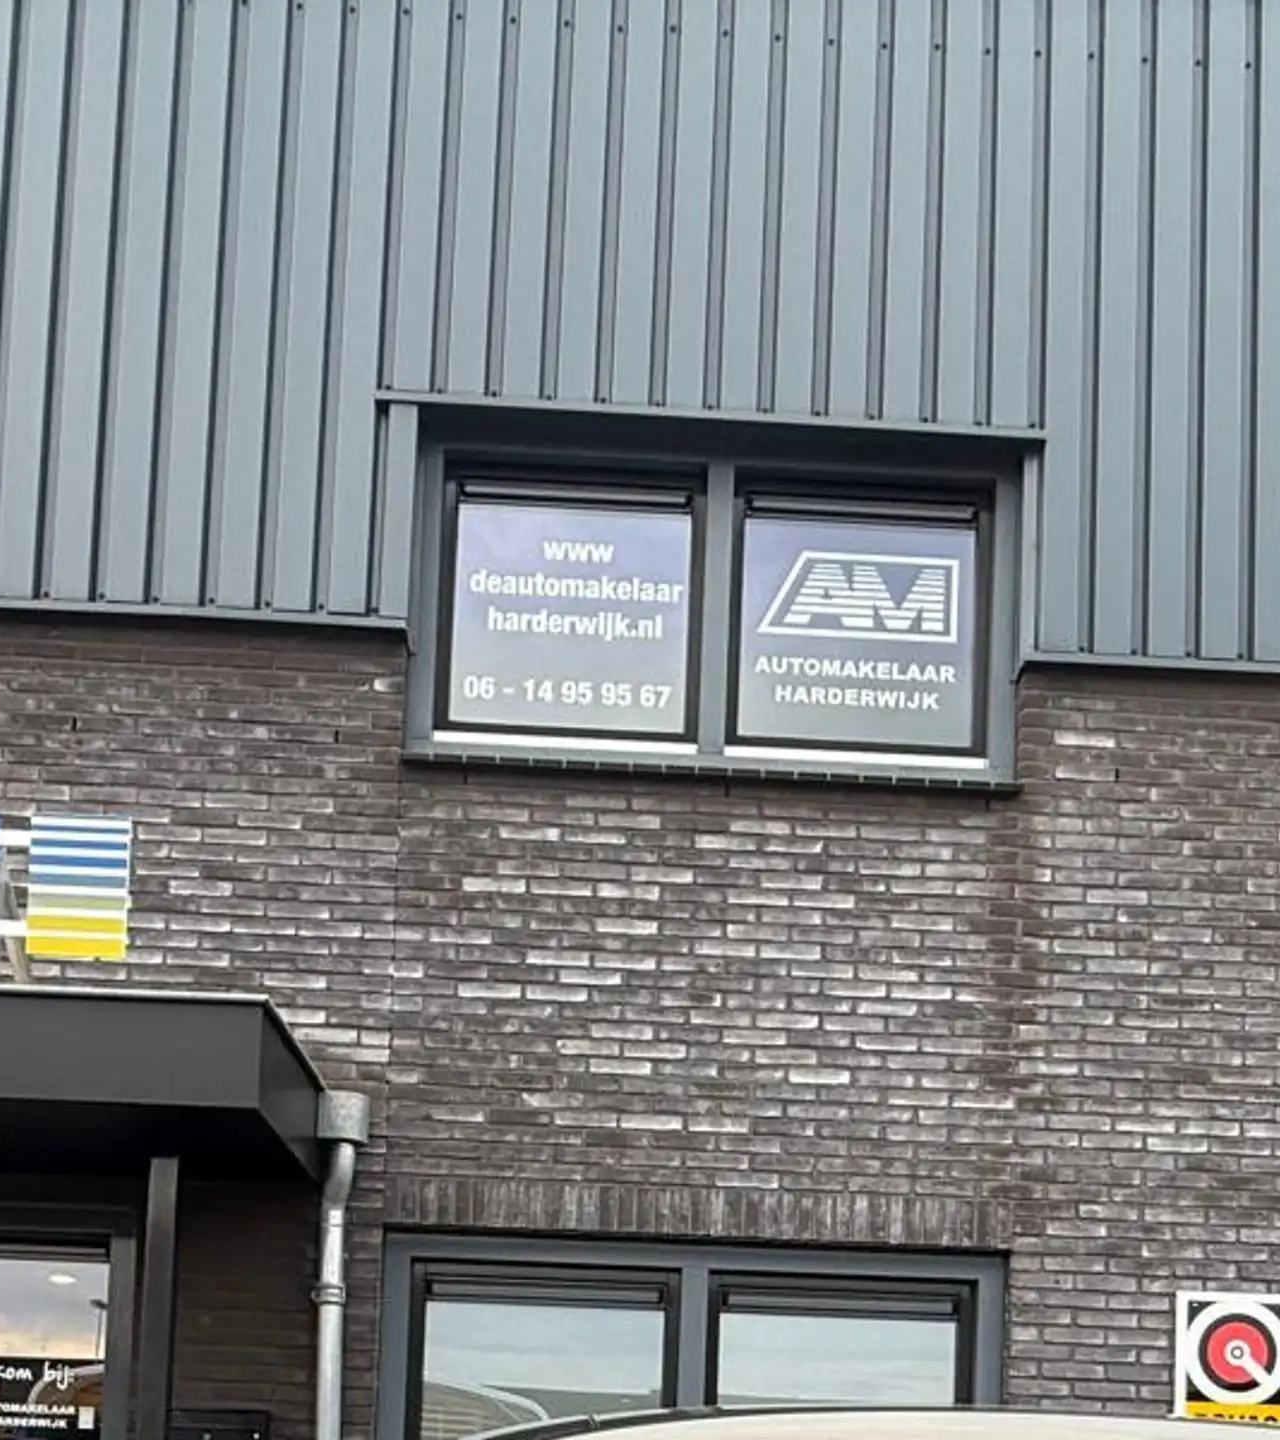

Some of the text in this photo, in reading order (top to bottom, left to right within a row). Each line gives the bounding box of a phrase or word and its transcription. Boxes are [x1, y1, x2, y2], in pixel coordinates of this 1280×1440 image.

[543, 541, 614, 563] www
[470, 569, 683, 605] deautomakelaar
[784, 564, 945, 632] AM
[487, 608, 662, 641] harderwijk.nl
[754, 656, 956, 683] AUTOMAKELAAR
[463, 675, 495, 699] 06
[524, 679, 553, 702] 14
[560, 680, 593, 704] 95
[600, 682, 632, 706] 95
[640, 684, 672, 709] 67
[775, 684, 939, 711] HARDERWIJK
[44, 1361, 75, 1390] bij:
